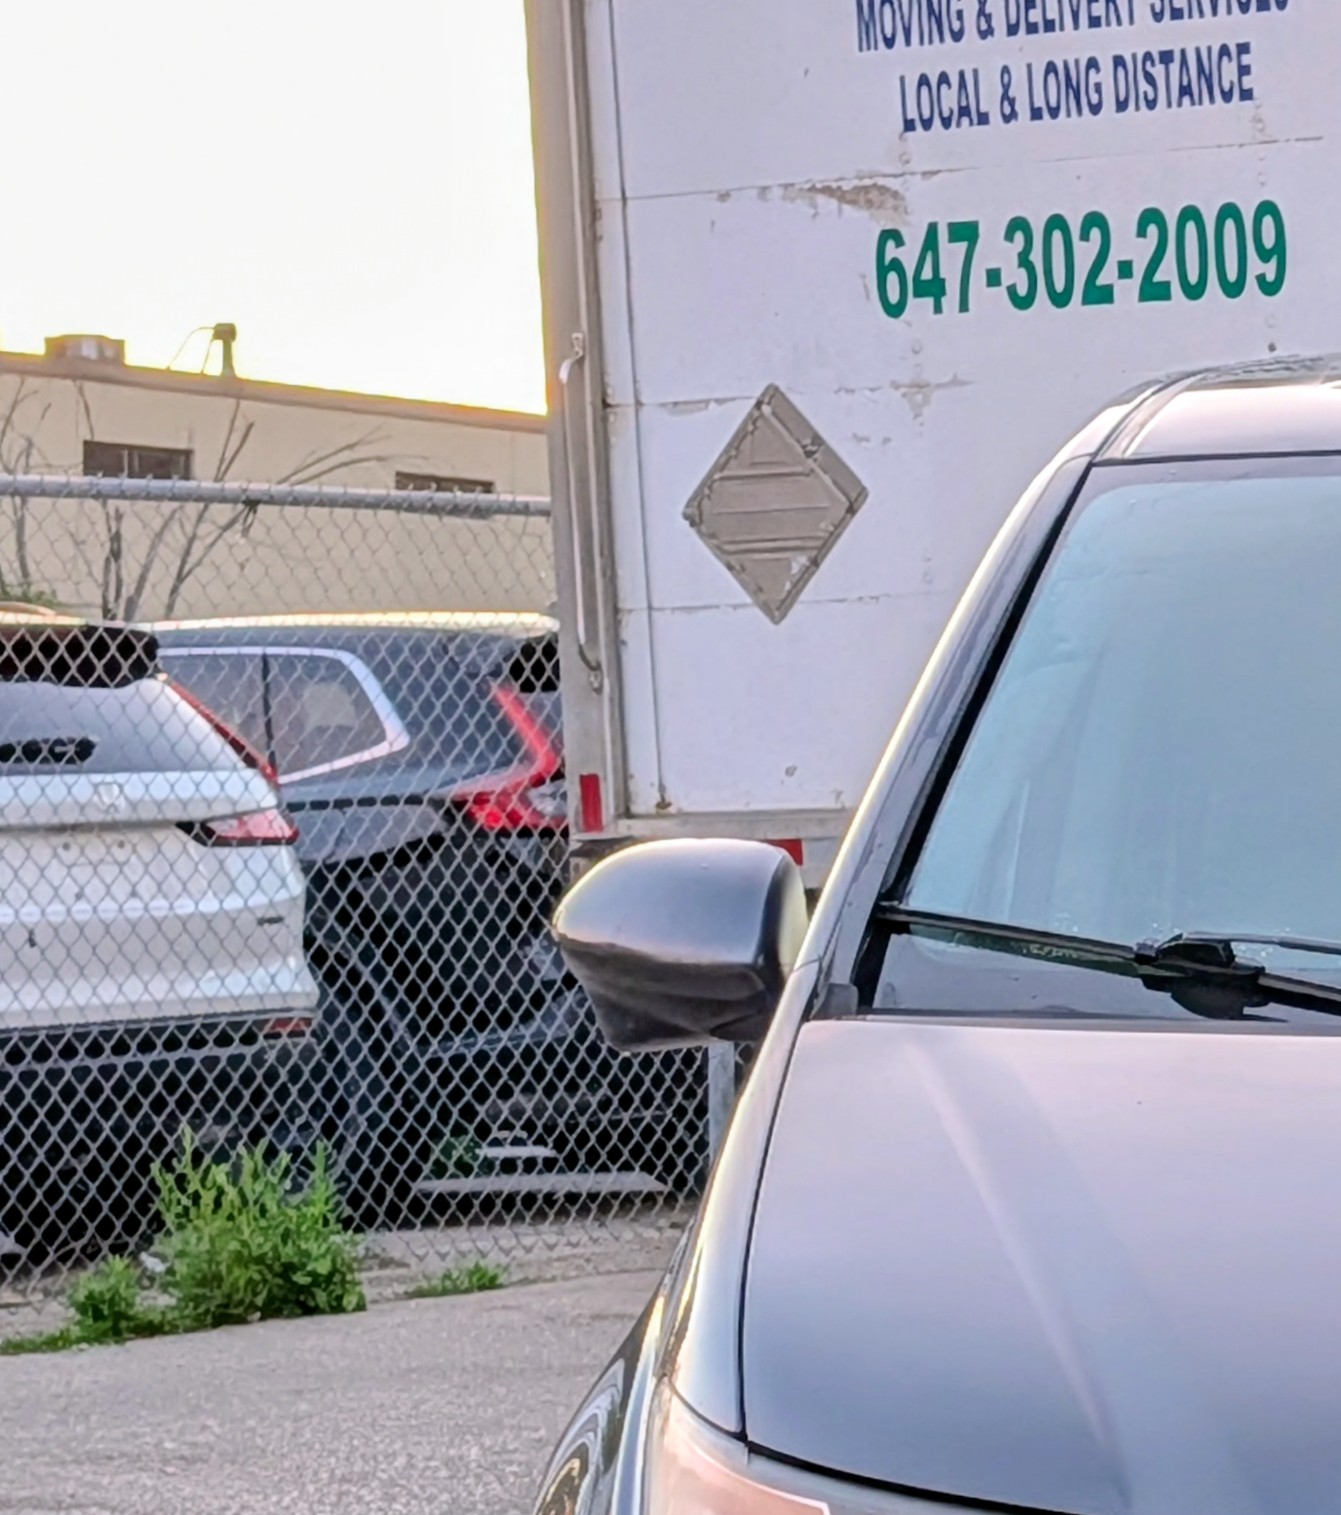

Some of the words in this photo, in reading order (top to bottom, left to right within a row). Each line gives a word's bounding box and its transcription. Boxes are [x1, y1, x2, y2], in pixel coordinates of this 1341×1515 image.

[855, 0, 966, 52] MOVING
[975, 0, 996, 41] &
[898, 67, 991, 133] LOCAL
[999, 63, 1019, 125] &
[1025, 55, 1104, 122] LONG
[1111, 41, 1254, 114] DISTANCE
[875, 199, 1288, 319] 647-302-2009
